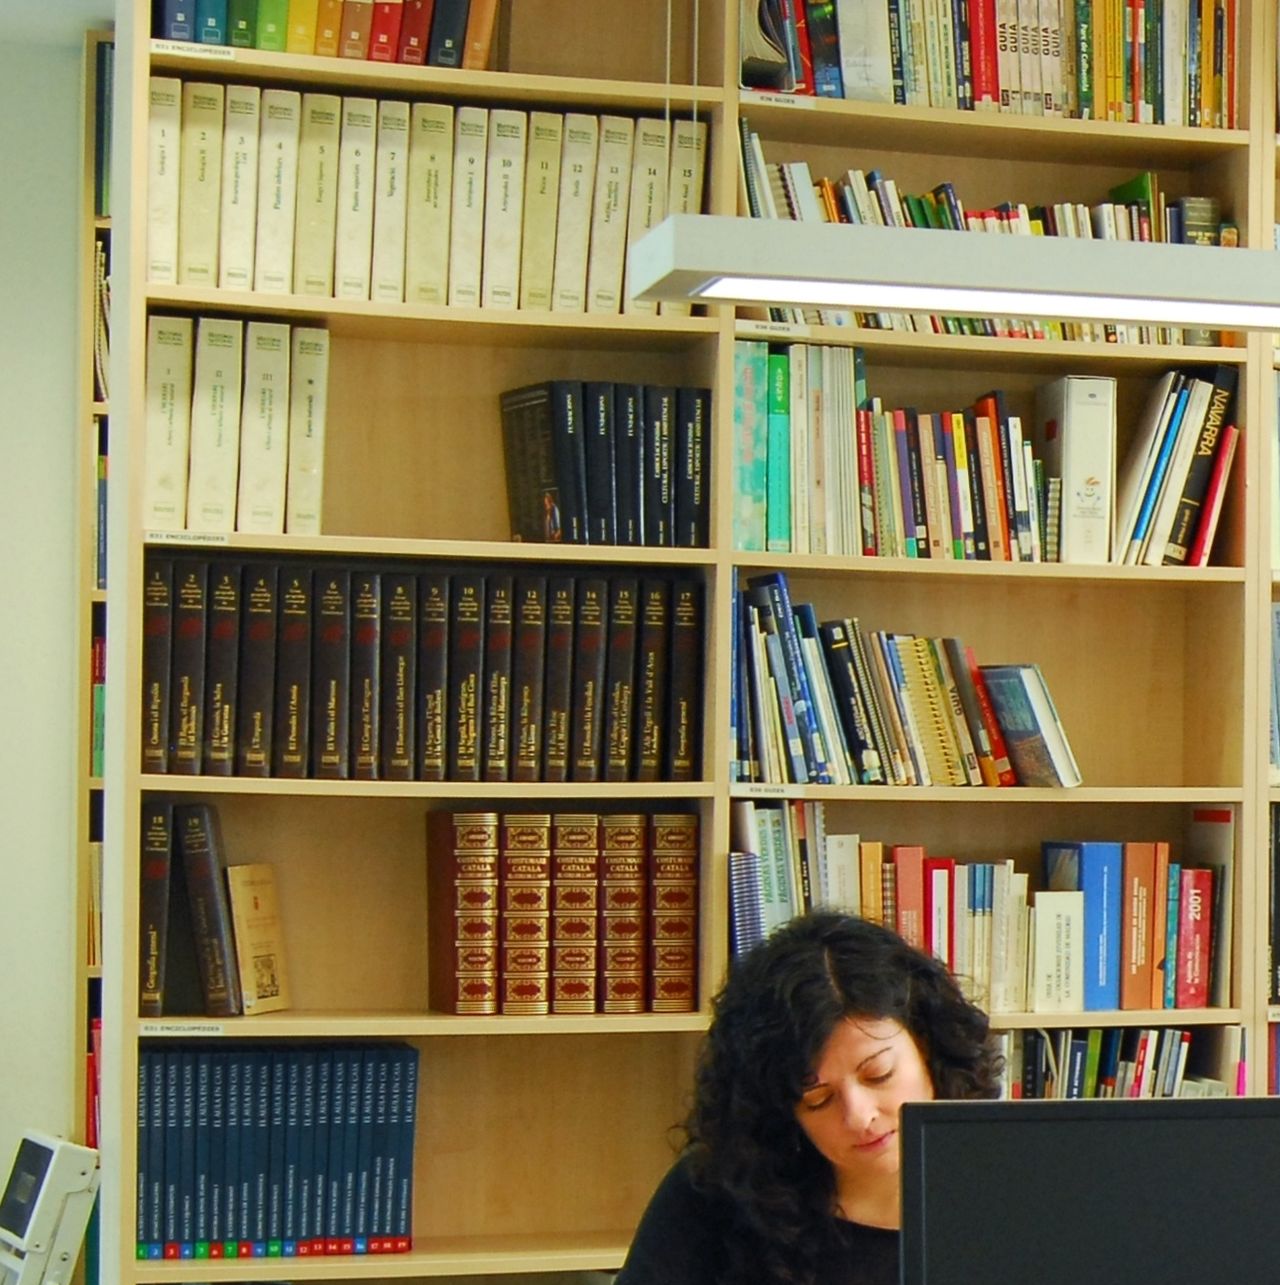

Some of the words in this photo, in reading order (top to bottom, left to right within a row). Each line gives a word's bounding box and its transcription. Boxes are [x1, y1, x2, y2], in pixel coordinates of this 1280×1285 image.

[999, 22, 1008, 51] GUIA
[1009, 23, 1019, 53] GUIA
[1021, 25, 1030, 54] GUIA
[1031, 26, 1040, 55] GUIA
[1041, 26, 1051, 56] GUIA
[1051, 28, 1060, 57] GUIA
[1197, 388, 1230, 456] NAVARRA
[948, 685, 963, 716] Vino
[1188, 888, 1202, 920] 2001
